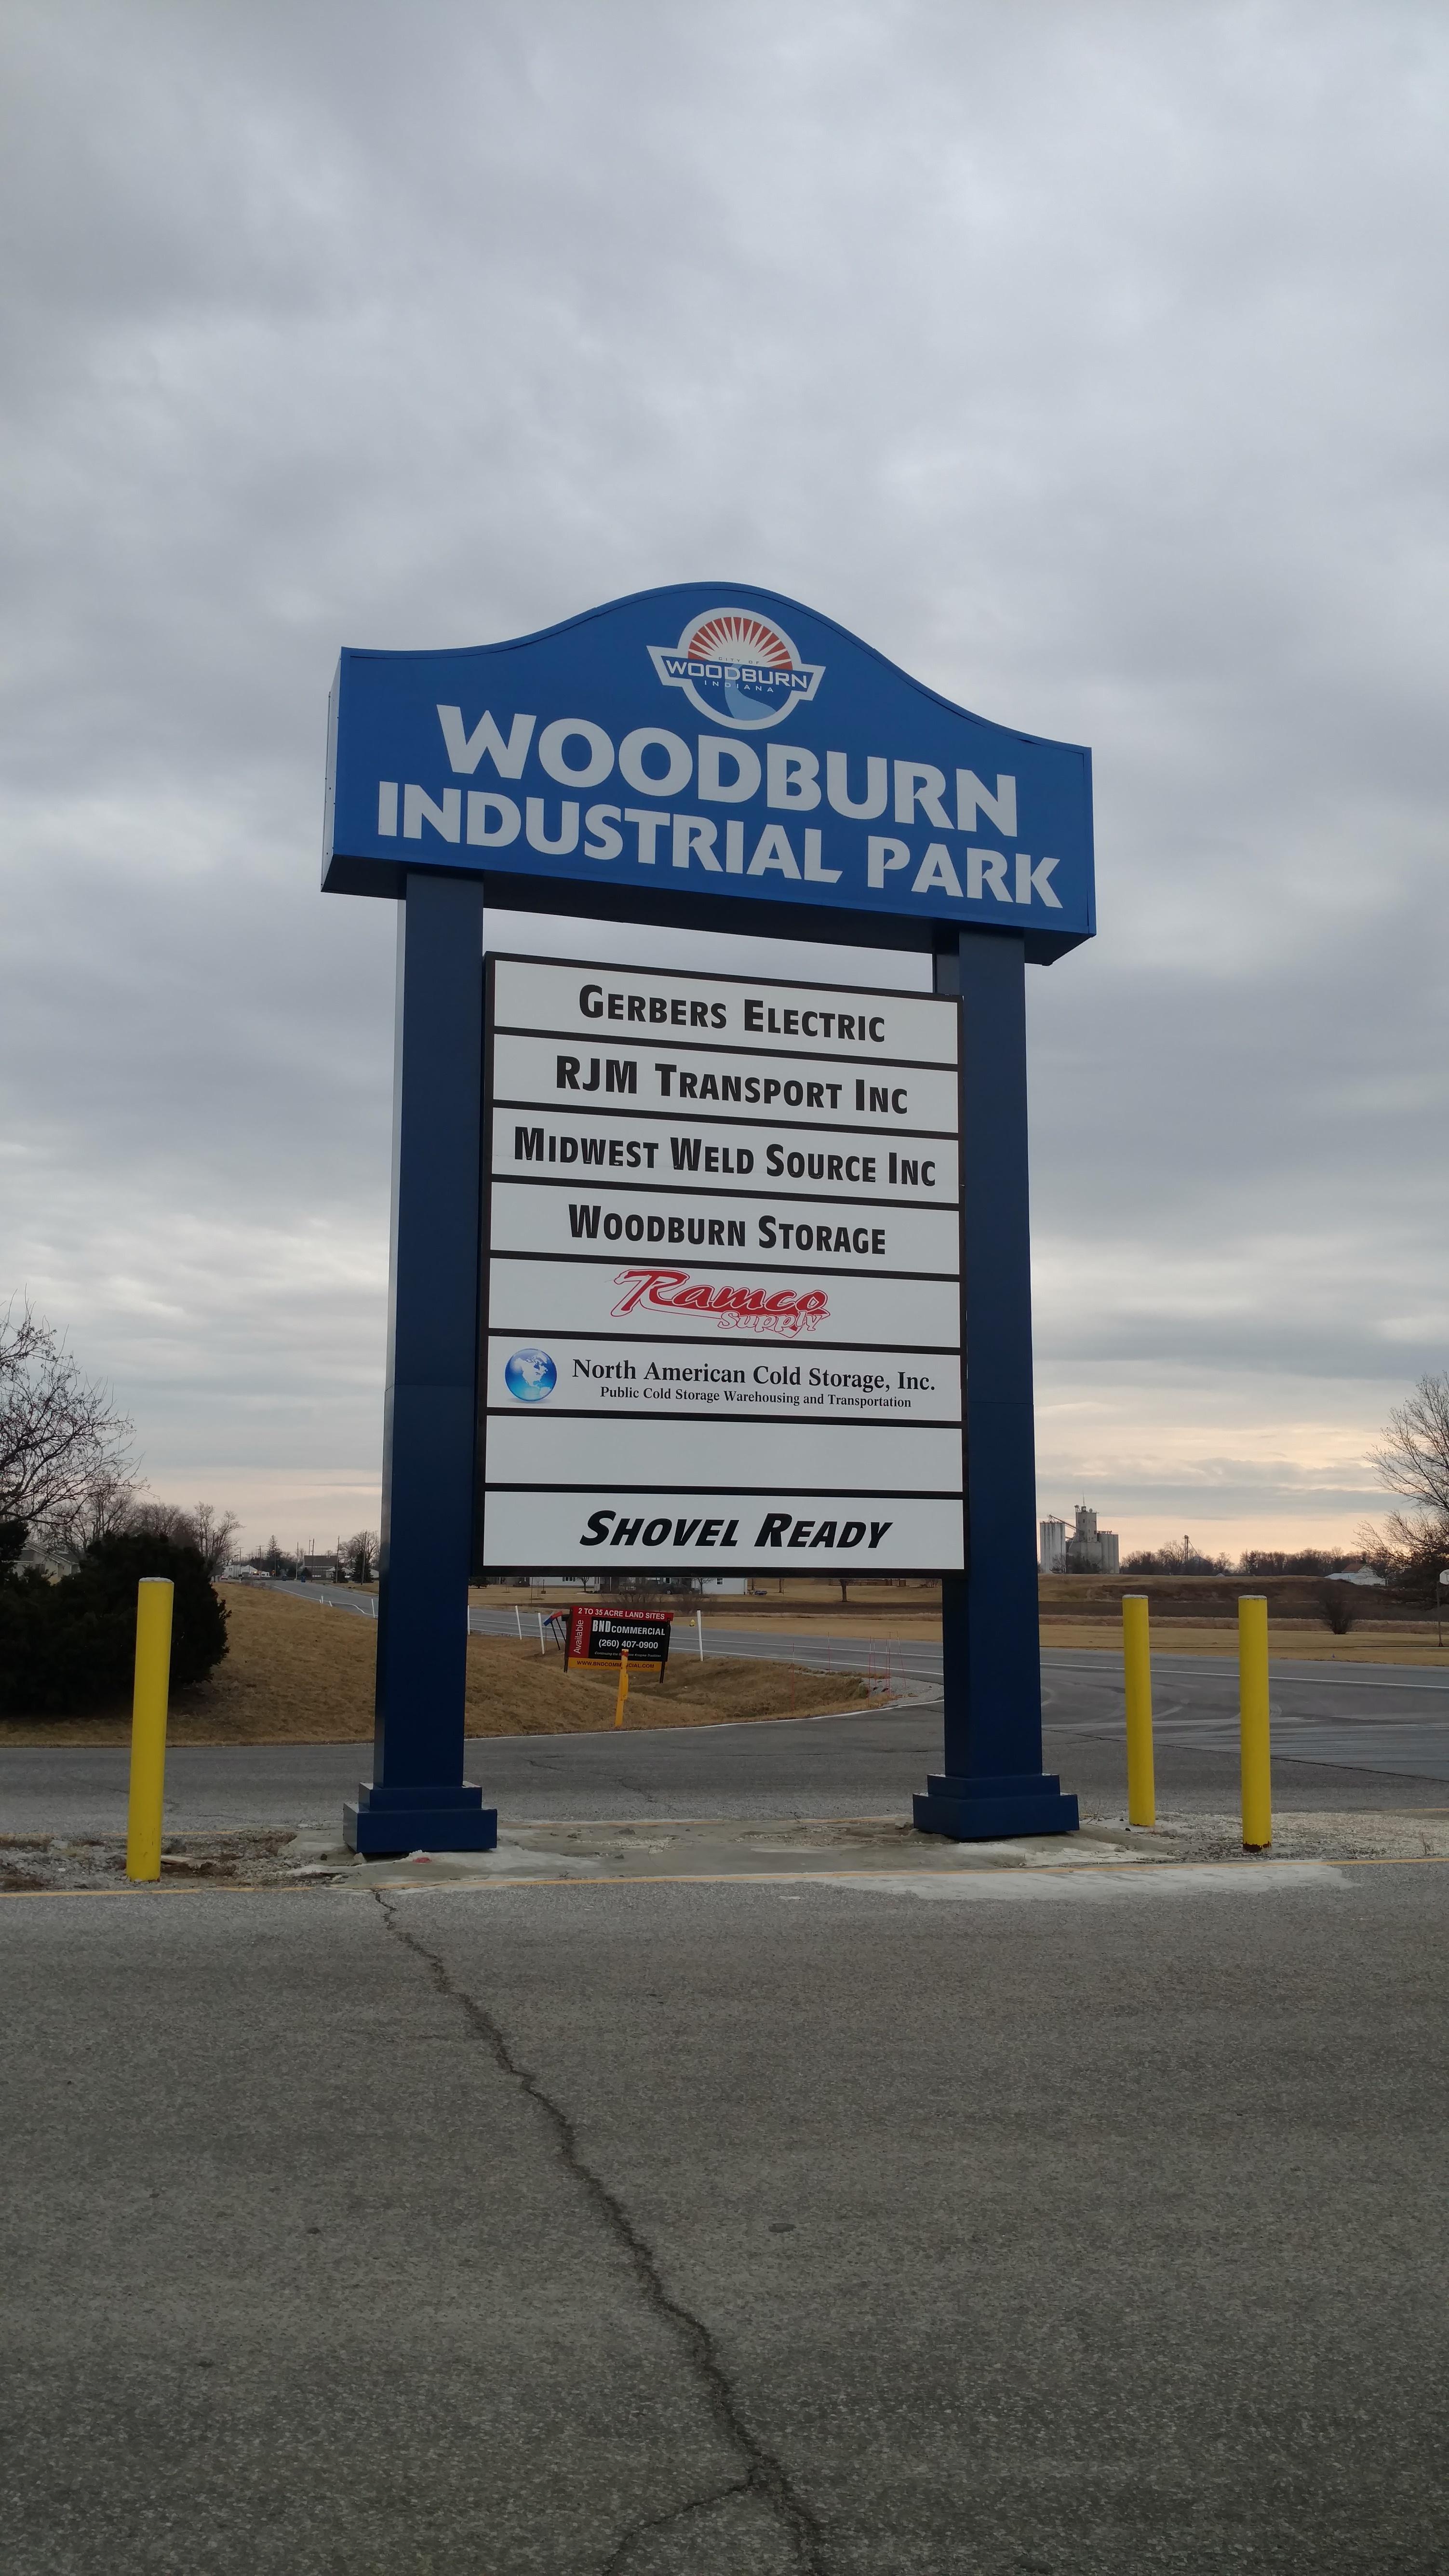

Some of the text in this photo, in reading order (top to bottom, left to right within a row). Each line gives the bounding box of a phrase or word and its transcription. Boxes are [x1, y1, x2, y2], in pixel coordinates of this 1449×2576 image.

[665, 660, 808, 689] WOODBURN
[704, 680, 774, 693] INDIANA
[437, 704, 1017, 837] WOODBURN
[378, 781, 1063, 908] INDUSTRIAL PARK
[579, 985, 884, 1042] GERBERS ELECTRIC
[557, 1056, 907, 1114] RJM TRANSPORT INC
[515, 1127, 935, 1186] MIDWEST WELD SOURCE INC
[569, 1204, 885, 1254] WOODBURN STORAGE
[611, 1269, 830, 1317] Ramco
[717, 1310, 822, 1333] Supply
[572, 1359, 935, 1393] North American Cold Storage, Inc.
[600, 1387, 911, 1408] Public Cold Storage Warehousing and Transportation
[579, 1510, 893, 1548] SHOVEL READY
[573, 1619, 584, 1654] Available
[599, 1639, 658, 1649] (260) 407-0900
[577, 1660, 655, 1668] WWW.BNDCOMMCIAL.COM
